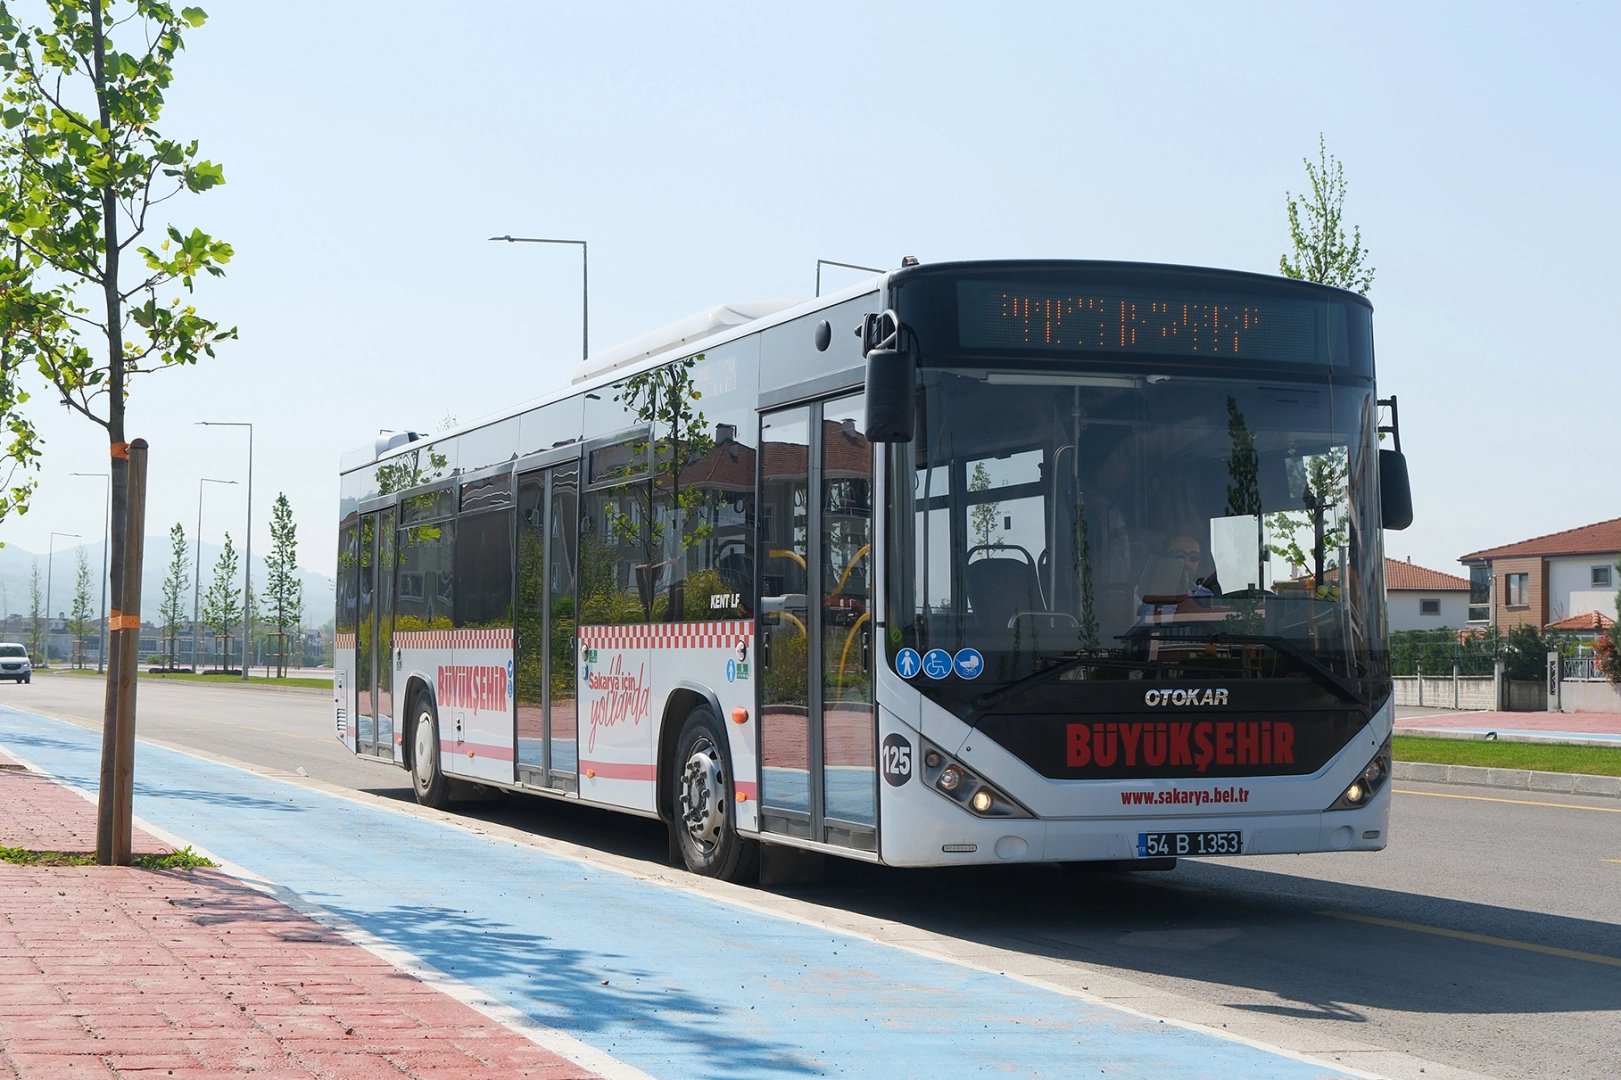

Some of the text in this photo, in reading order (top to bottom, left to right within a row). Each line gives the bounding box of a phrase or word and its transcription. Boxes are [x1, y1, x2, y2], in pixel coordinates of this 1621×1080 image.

[710, 593, 741, 609] KENT LF
[589, 672, 636, 694] Sakarya için
[588, 653, 650, 754] yollarda
[1144, 688, 1229, 706] OTOKAR
[883, 745, 911, 775] 125
[1121, 786, 1250, 806] www.sakarya.bel.tr
[1147, 833, 1239, 855] 54 B 1353
